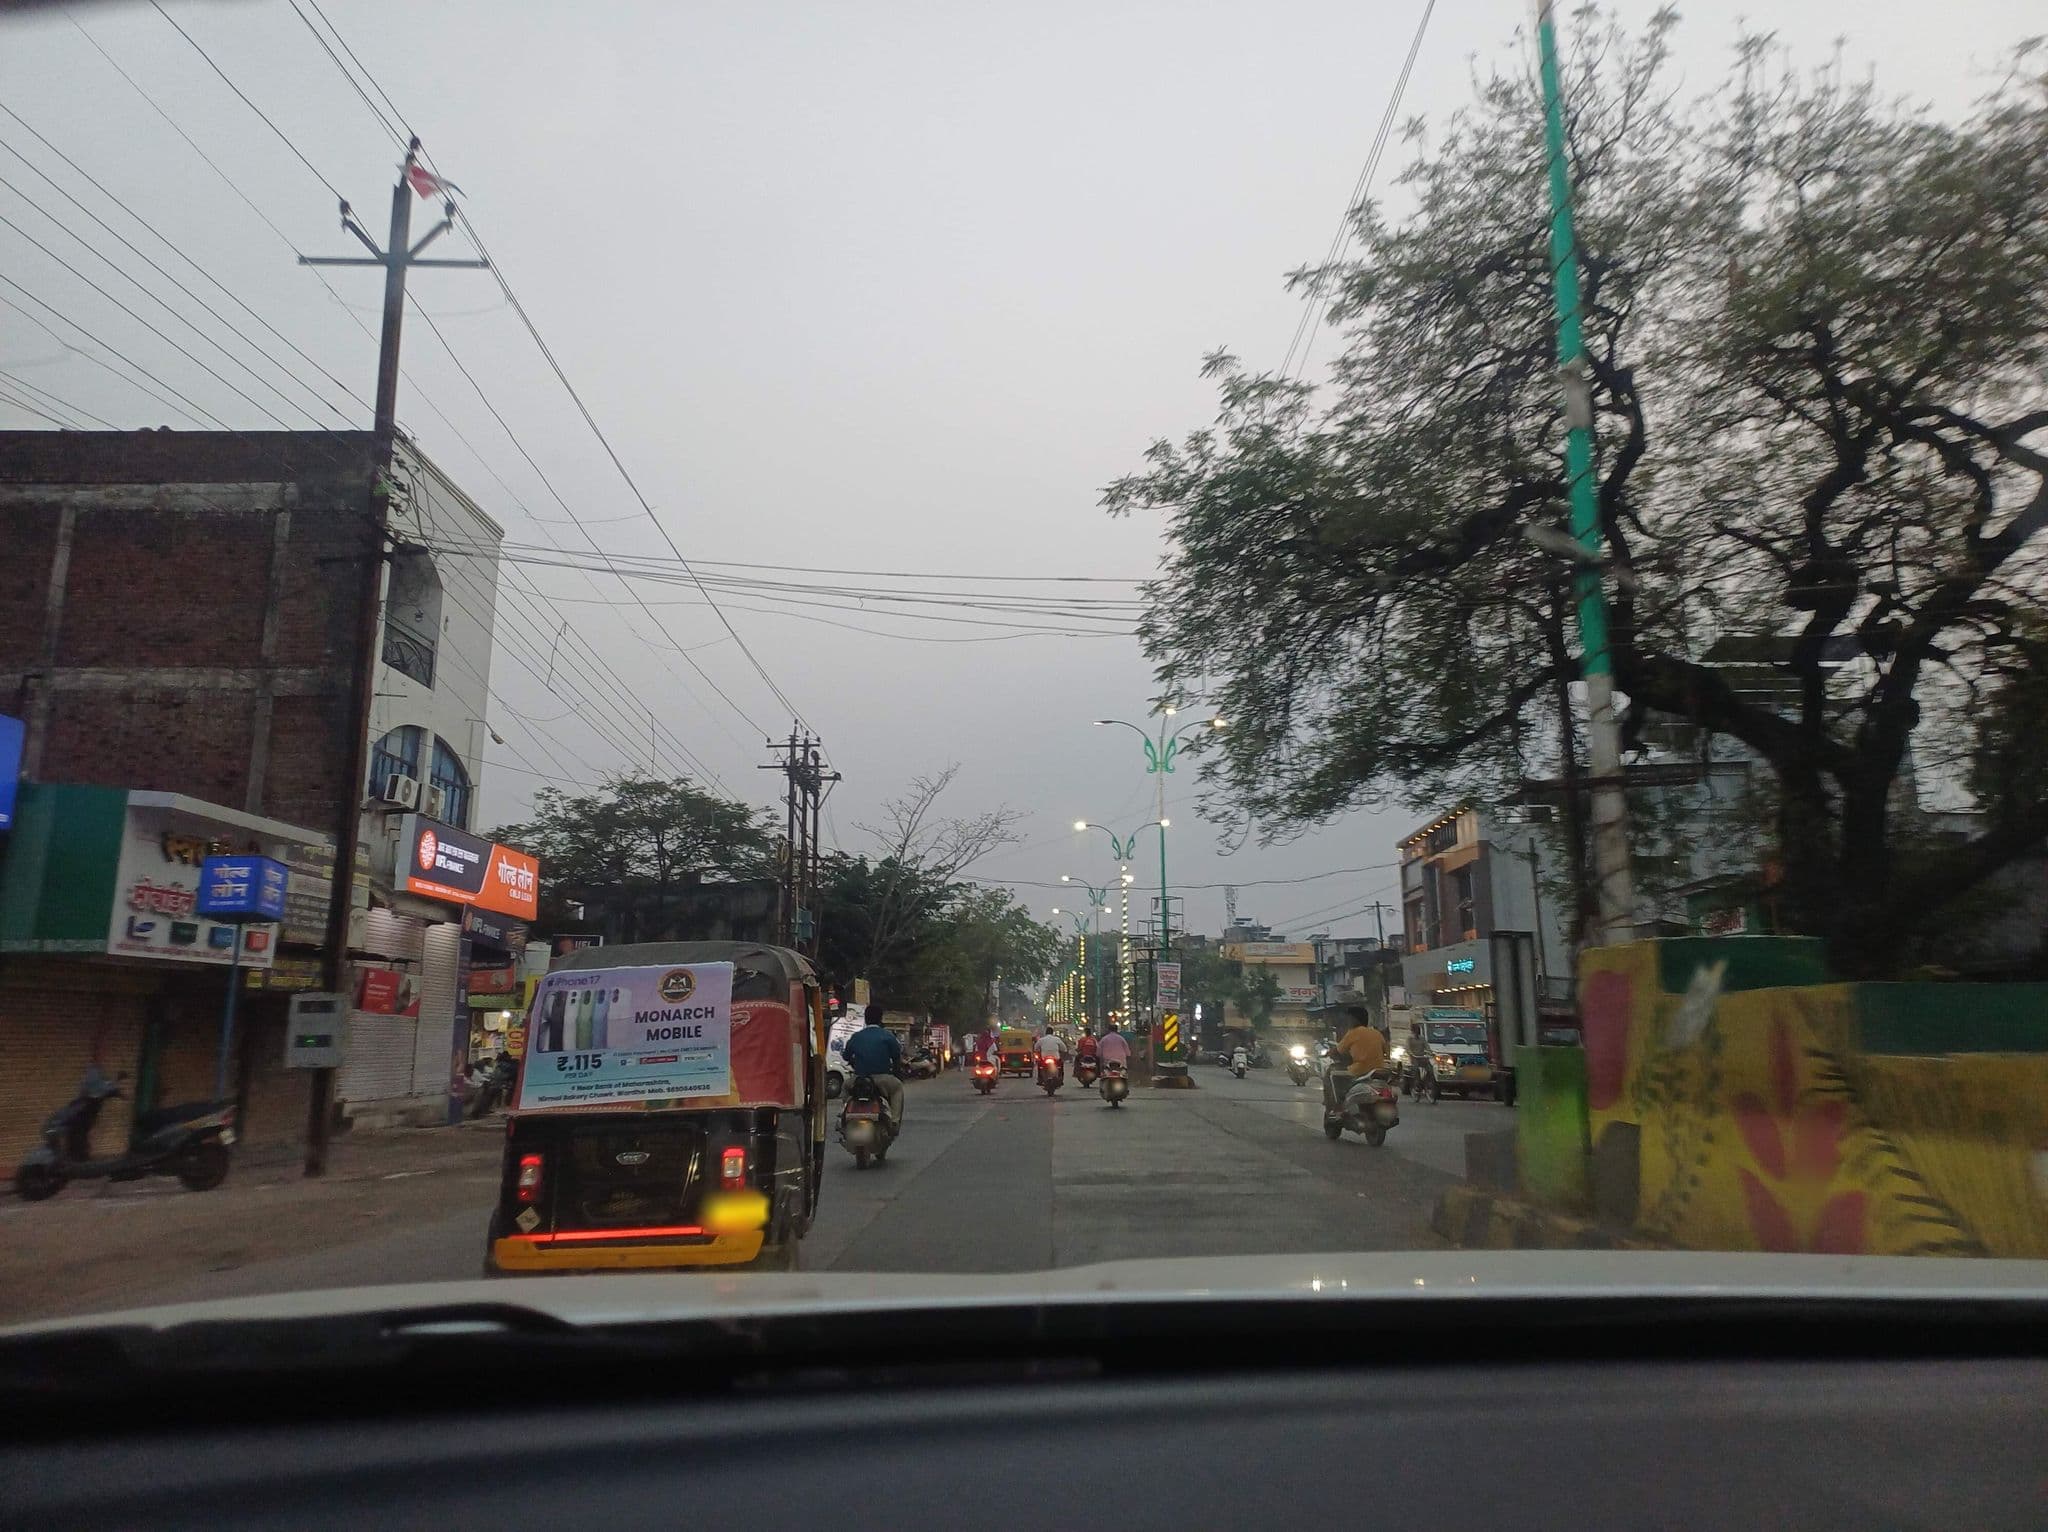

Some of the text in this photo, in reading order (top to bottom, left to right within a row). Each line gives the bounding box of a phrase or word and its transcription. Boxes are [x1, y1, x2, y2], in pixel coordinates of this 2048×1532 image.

[517, 862, 534, 892] लोन
[553, 975, 601, 987] iPhone 17
[634, 1006, 715, 1023] MONARCH
[646, 1025, 702, 1041] MOBILE
